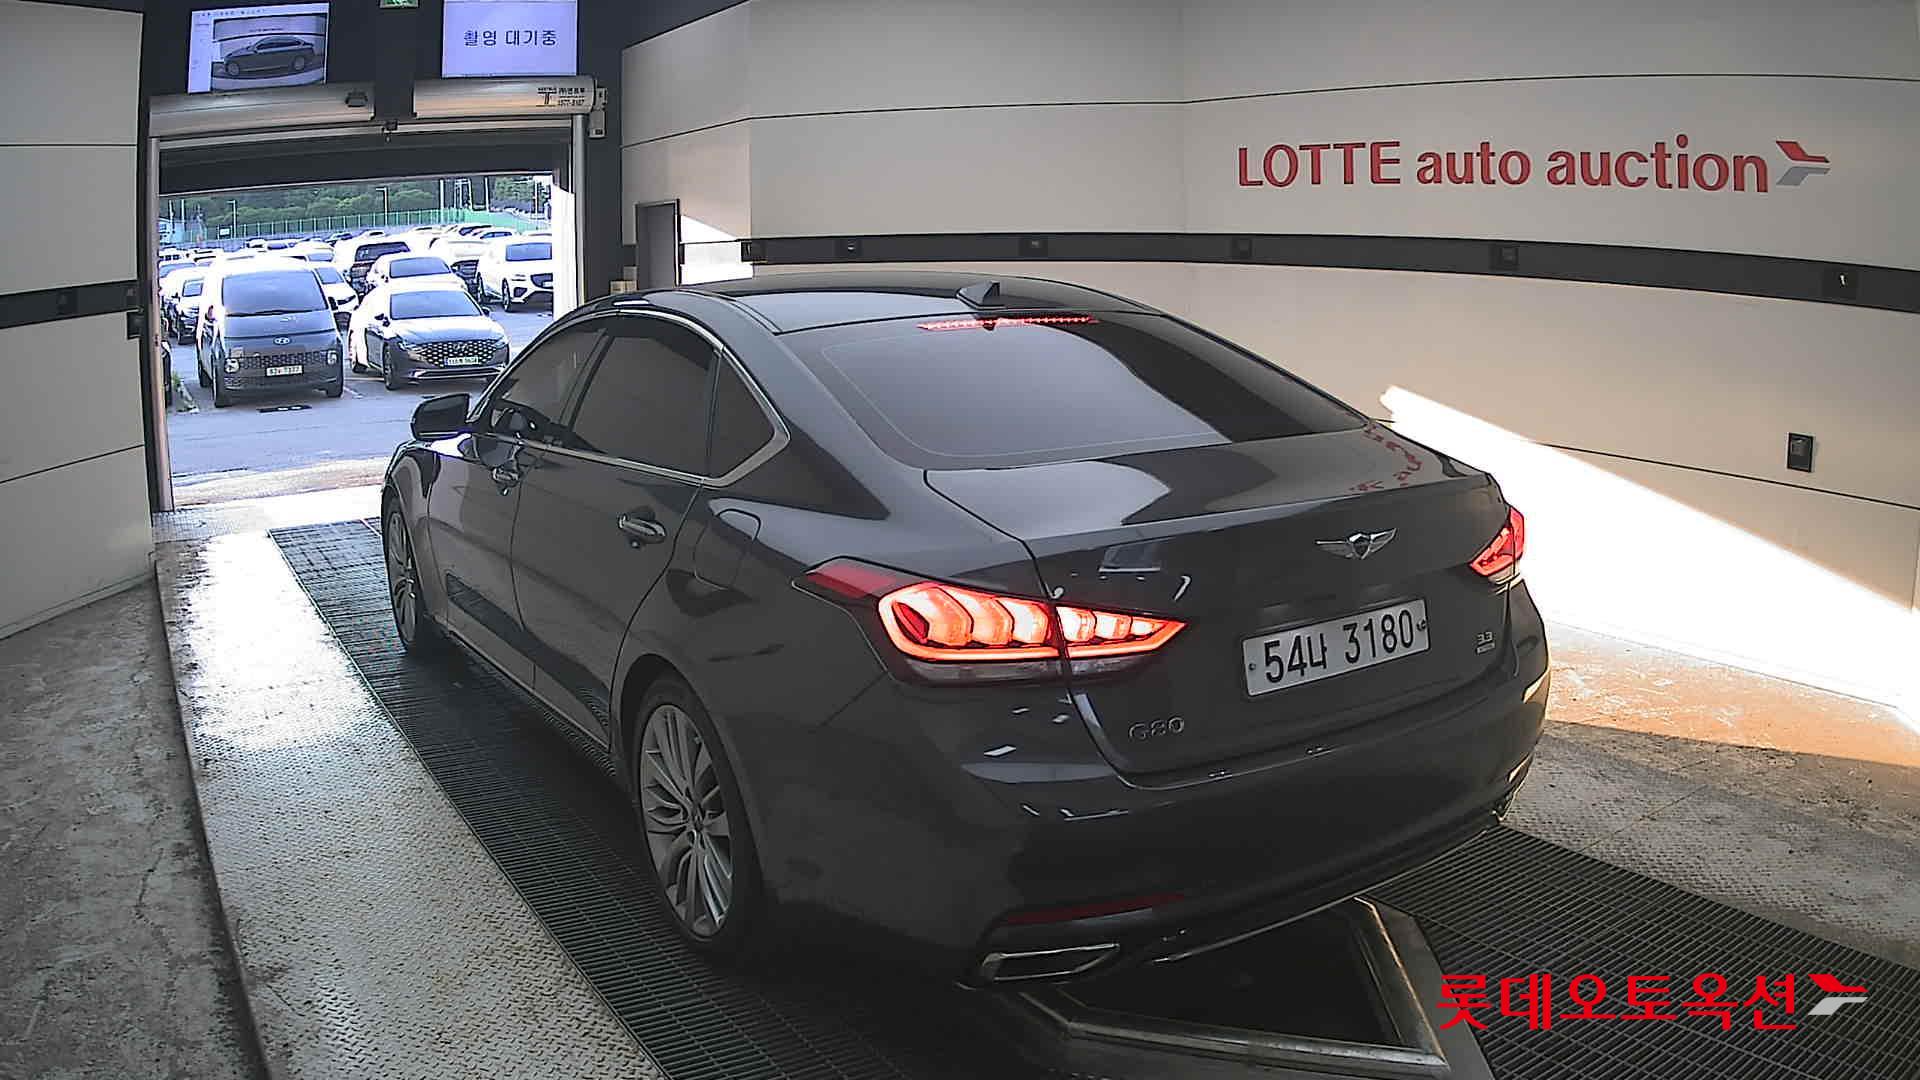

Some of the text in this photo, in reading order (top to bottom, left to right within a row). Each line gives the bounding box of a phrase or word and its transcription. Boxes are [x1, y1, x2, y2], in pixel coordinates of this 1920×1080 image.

[463, 30, 557, 46] 촬영 대기중
[1238, 135, 1769, 193] LOTTE auto auction
[1264, 610, 1414, 683] 54나 3180
[1128, 716, 1185, 741] G80
